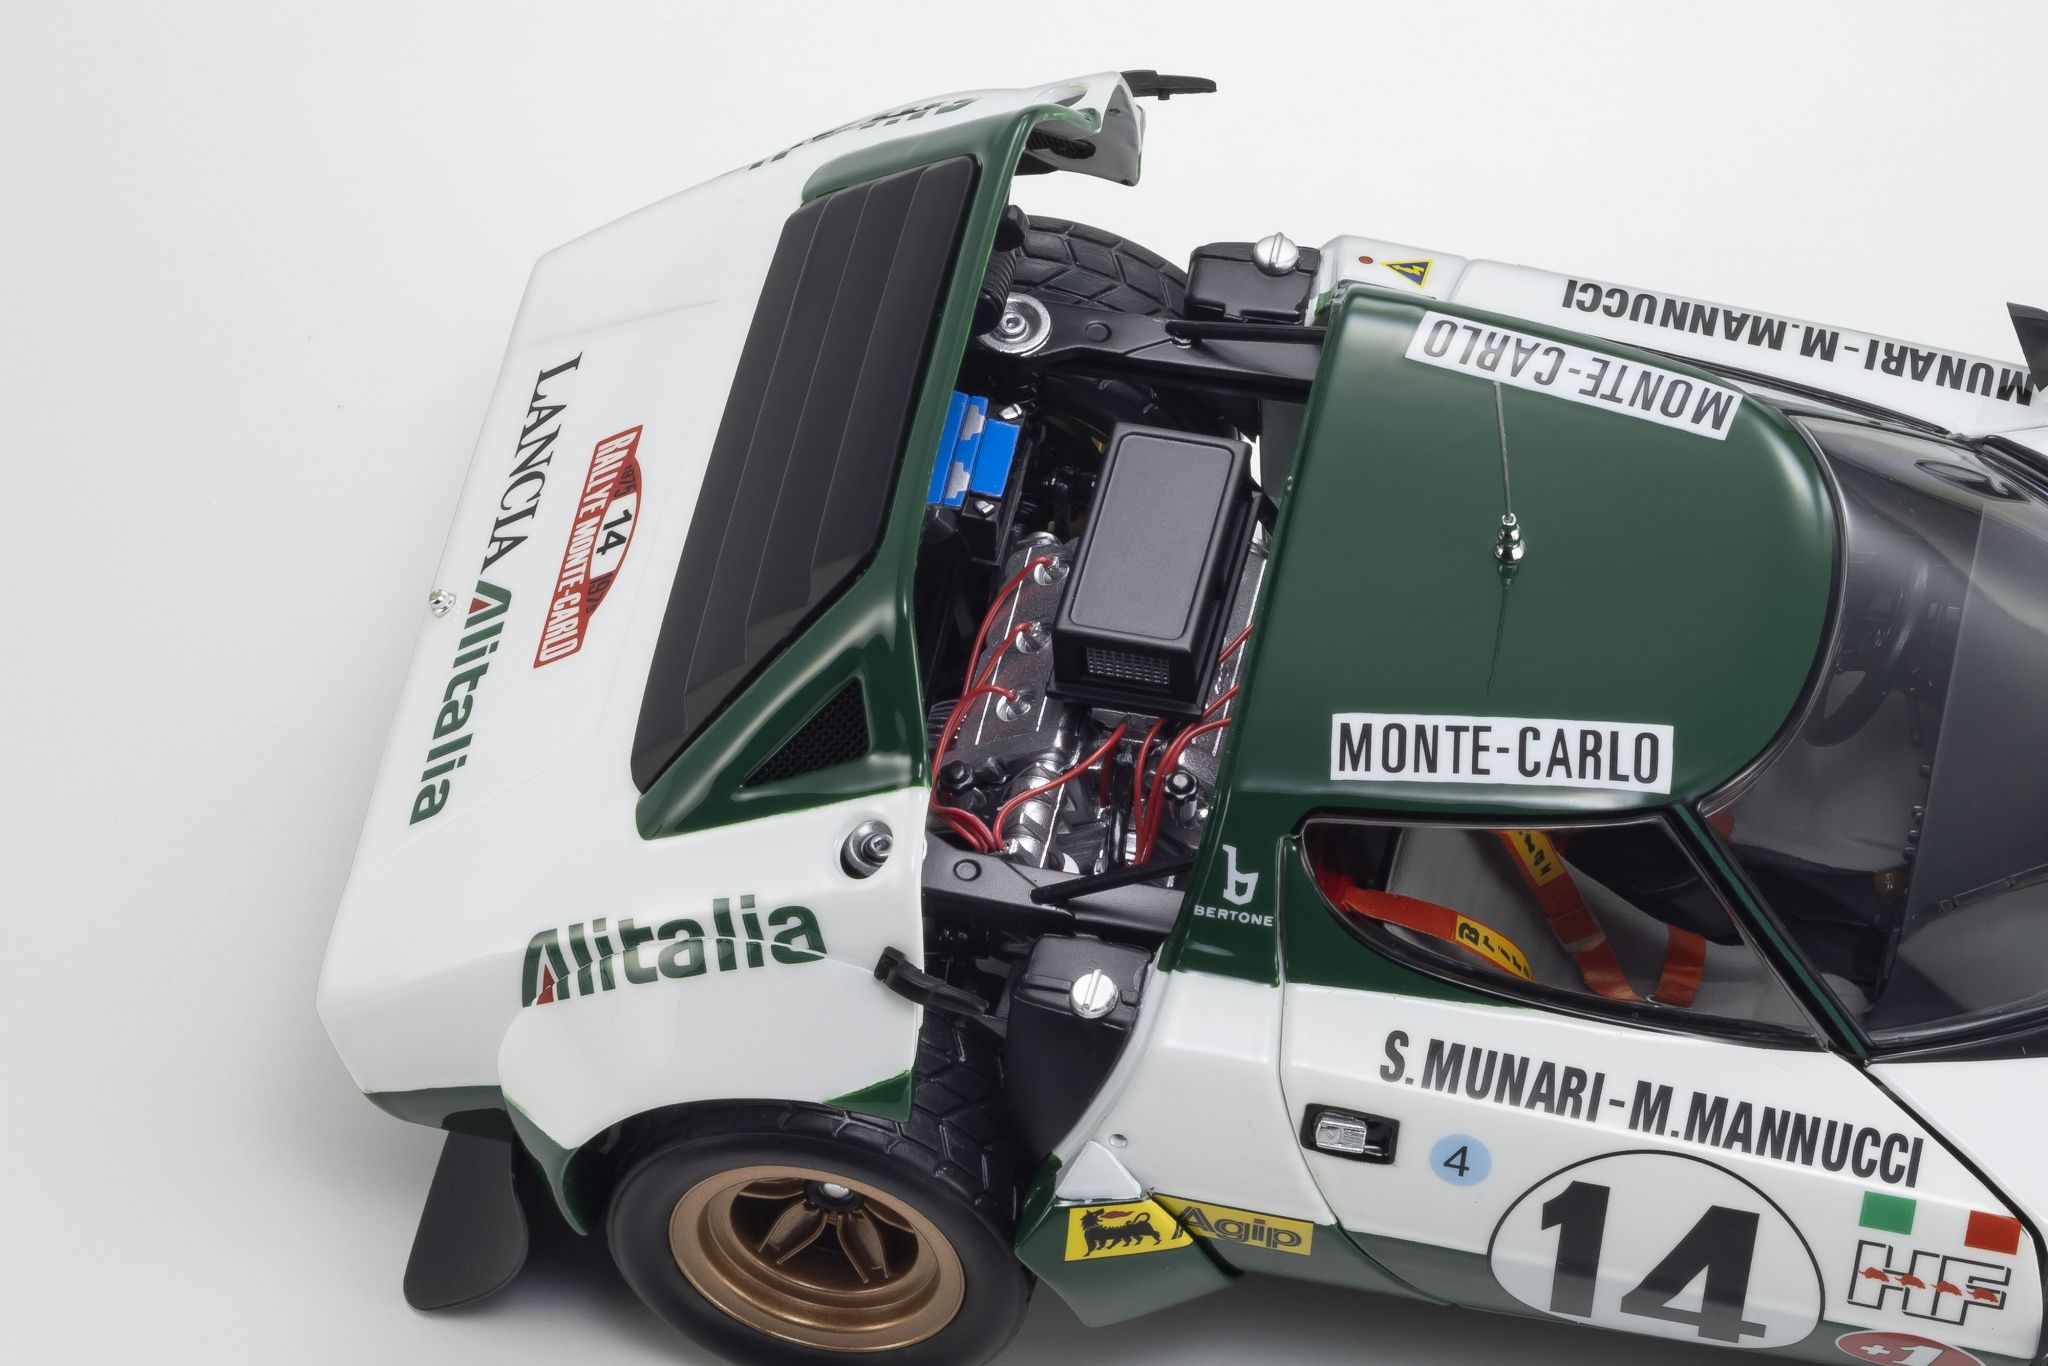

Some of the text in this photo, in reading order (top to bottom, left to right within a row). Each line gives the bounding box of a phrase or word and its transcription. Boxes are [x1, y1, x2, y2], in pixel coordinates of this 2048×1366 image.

[1424, 318, 1734, 432] MONTE-CARLO
[481, 351, 582, 574] LANCIA
[614, 464, 637, 498] 1975
[539, 431, 638, 662] RALLYE MONTE-CARLO
[597, 509, 632, 556] 14
[410, 580, 512, 825] Alitalia
[1338, 722, 1660, 784] MONTE-CARLO
[522, 894, 828, 1008] Alitalia
[1193, 904, 1274, 927] BERTONE
[1443, 1145, 1470, 1177] 4
[1171, 1206, 1302, 1248] Agip
[1541, 1180, 1767, 1344] 14
[1847, 1240, 2012, 1326] HF
